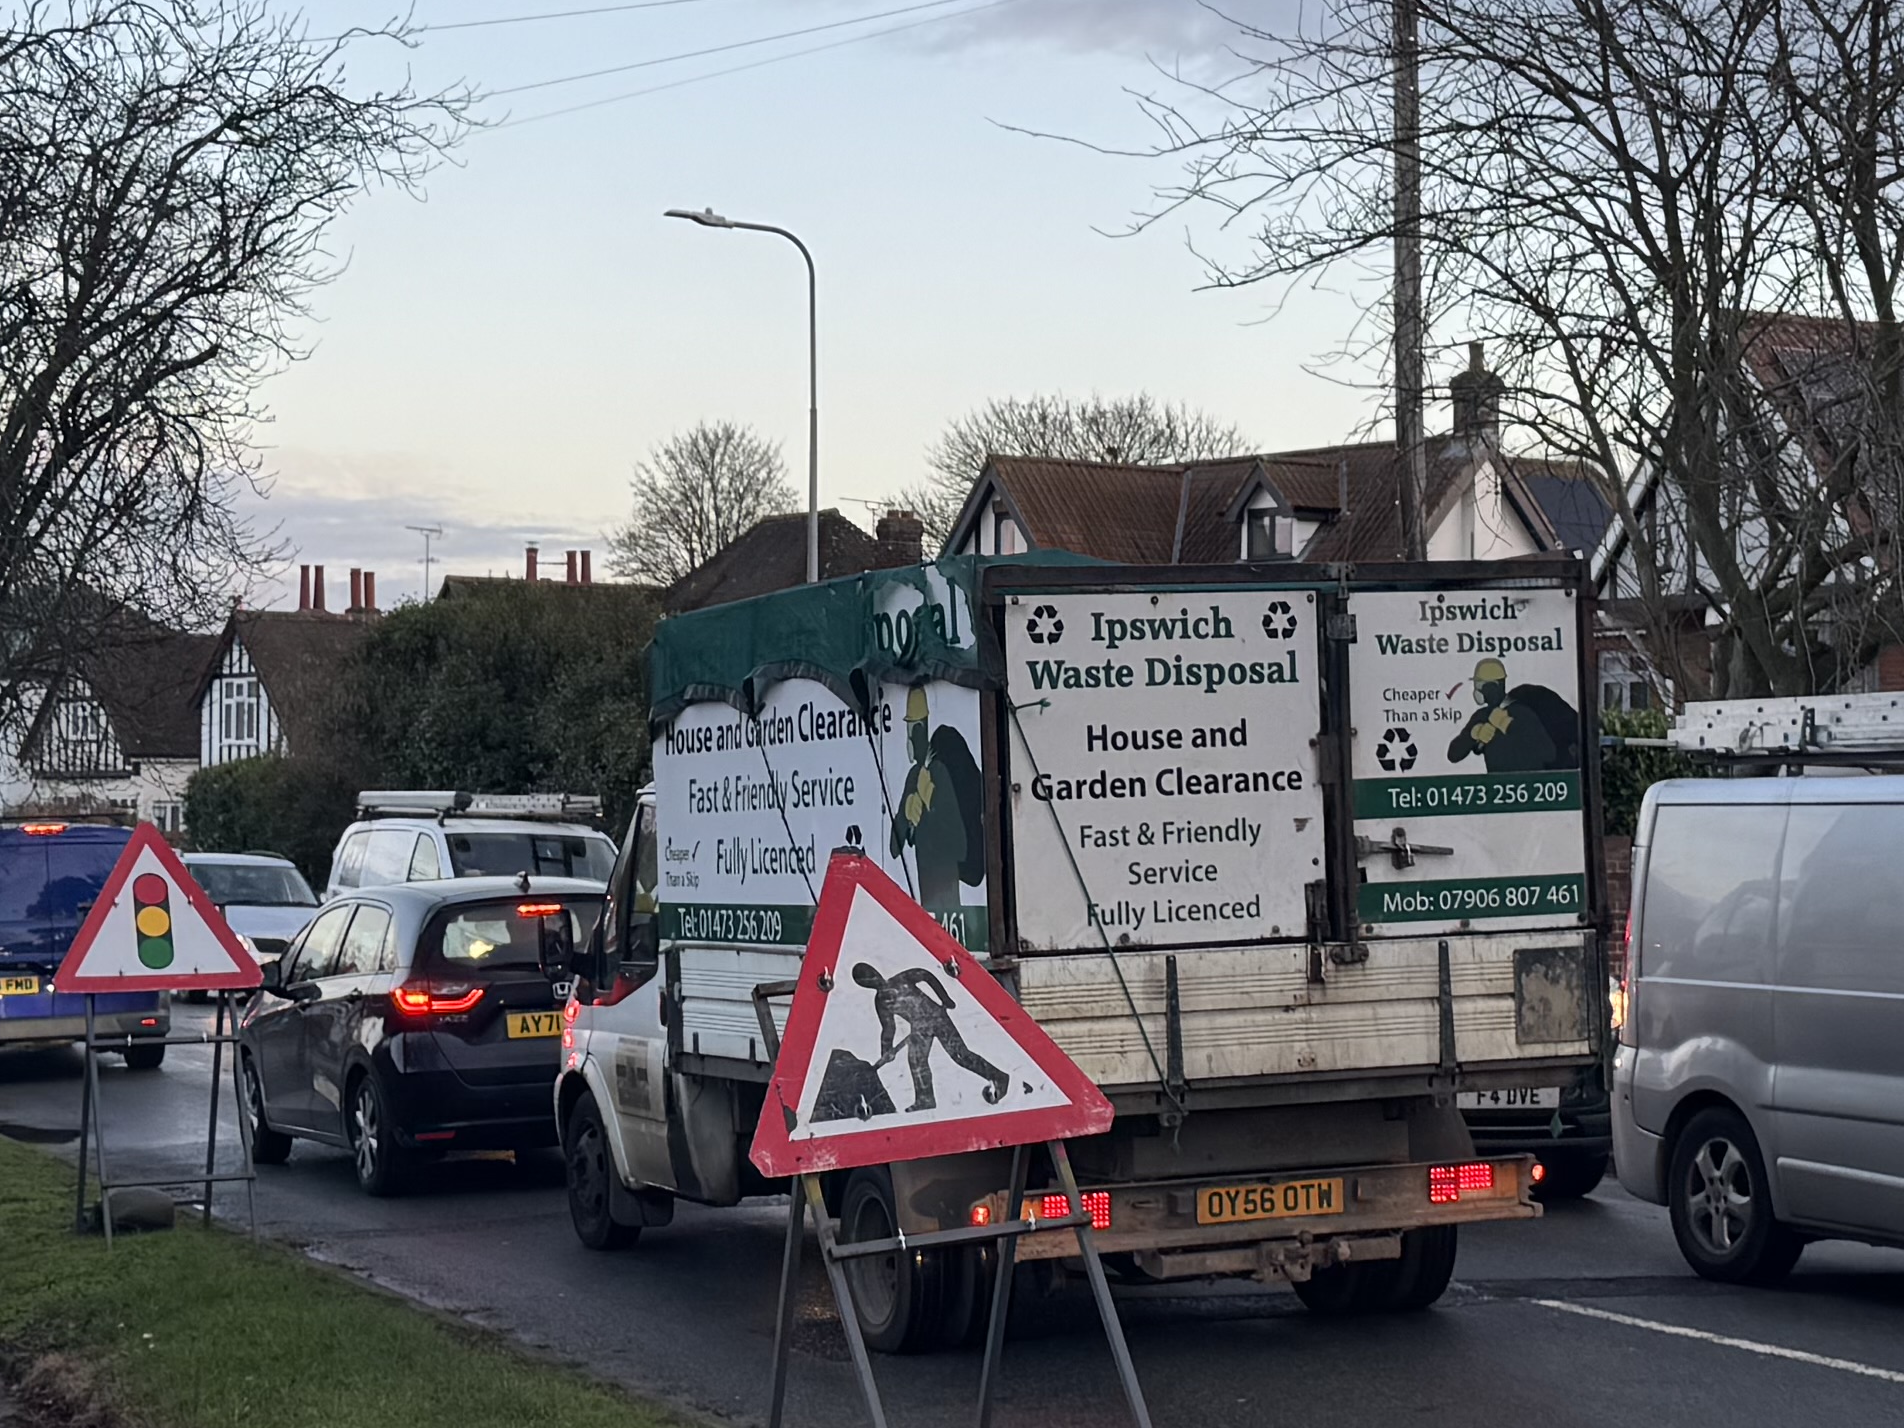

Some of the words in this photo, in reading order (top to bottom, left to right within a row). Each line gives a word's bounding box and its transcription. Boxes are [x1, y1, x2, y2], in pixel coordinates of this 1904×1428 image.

[1090, 605, 1235, 649] Ipswich
[1418, 596, 1518, 627] Ipswich
[1374, 633, 1449, 655] Waste
[1456, 627, 1564, 657] Disposal
[1026, 658, 1135, 690] Waste
[1145, 650, 1300, 694] Disposal
[1382, 687, 1441, 704] Cheaper
[665, 722, 713, 756] House
[716, 713, 743, 752] and
[745, 707, 794, 748] Garden
[797, 701, 892, 742] Clearance
[1383, 708, 1418, 723] Than
[1421, 711, 1430, 722] a
[1433, 707, 1463, 723] Skip
[1086, 724, 1183, 753] House
[1191, 718, 1248, 748] and
[688, 778, 719, 814] Fast
[722, 776, 732, 812] &
[735, 769, 788, 817] Friendly
[791, 767, 855, 809] Service
[1030, 770, 1146, 802] Garden
[1155, 766, 1303, 797] Clearance
[1387, 786, 1422, 808] Tel:
[1426, 785, 1487, 807] 01473
[1492, 783, 1529, 804] 256
[1533, 782, 1568, 802] 209
[1079, 825, 1130, 849] Fast
[1137, 822, 1156, 846] &
[1162, 817, 1262, 847] Friendly
[665, 840, 690, 864] Cheaper
[716, 836, 747, 885] Fully
[751, 834, 817, 876] Licenced
[665, 872, 680, 887] Than
[685, 872, 700, 891] Skip
[1127, 859, 1218, 886] Service
[1086, 901, 1146, 931] Fully
[1153, 894, 1261, 923] Licenced
[1382, 891, 1435, 913] Mob:
[1439, 888, 1501, 910] 07906
[1505, 886, 1541, 907] 807
[1546, 884, 1579, 905] 461
[678, 907, 698, 939] Tel:
[699, 908, 735, 940] 01473
[736, 910, 757, 940] 256
[760, 910, 782, 942] 209
[5, 978, 33, 991] FMD
[520, 1014, 561, 1034] AY71
[1476, 1090, 1501, 1105] F4
[1506, 1087, 1541, 1105] DVE
[1207, 1186, 1275, 1218] OY56
[1282, 1181, 1333, 1212] OTW
